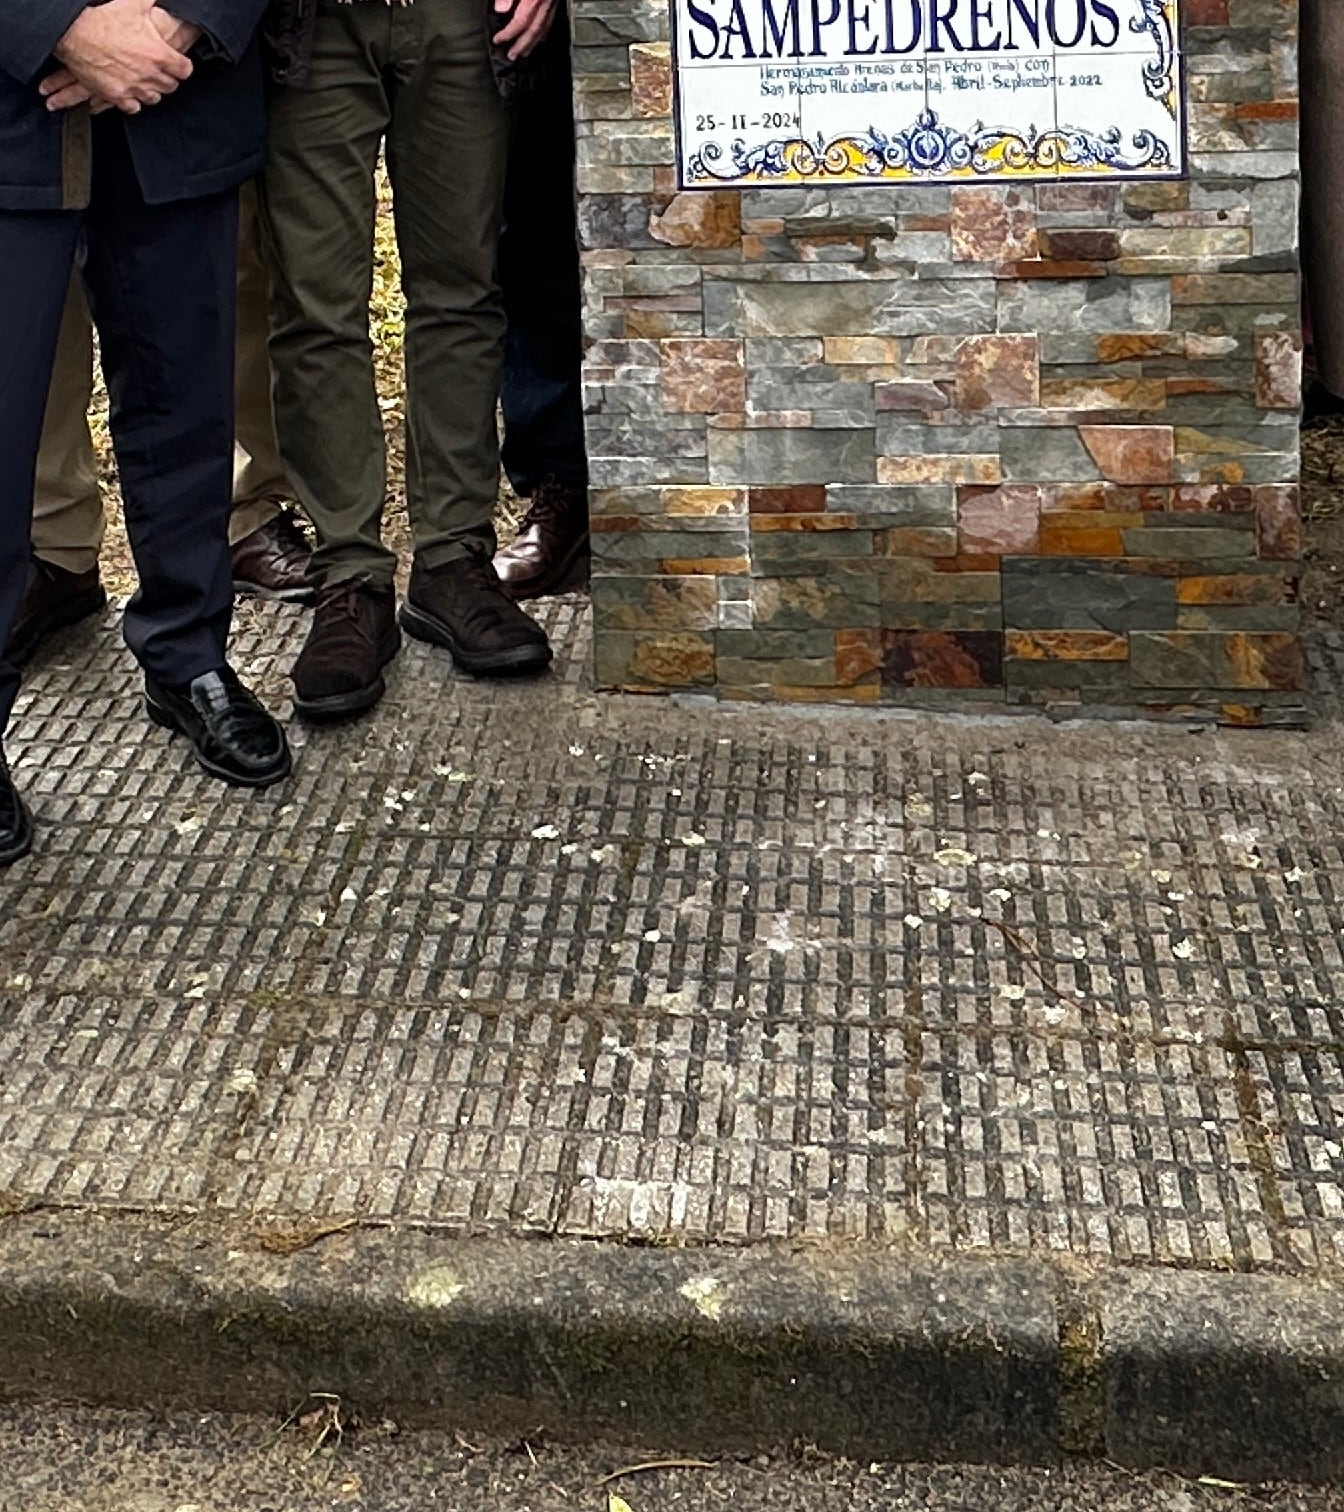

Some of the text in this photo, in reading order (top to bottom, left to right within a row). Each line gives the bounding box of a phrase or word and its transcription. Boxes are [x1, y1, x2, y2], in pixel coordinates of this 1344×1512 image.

[945, 59, 981, 73] Pedro
[1024, 58, 1050, 74] con
[760, 80, 784, 98] San
[789, 78, 827, 95] Pedro
[1069, 73, 1104, 88] 2022
